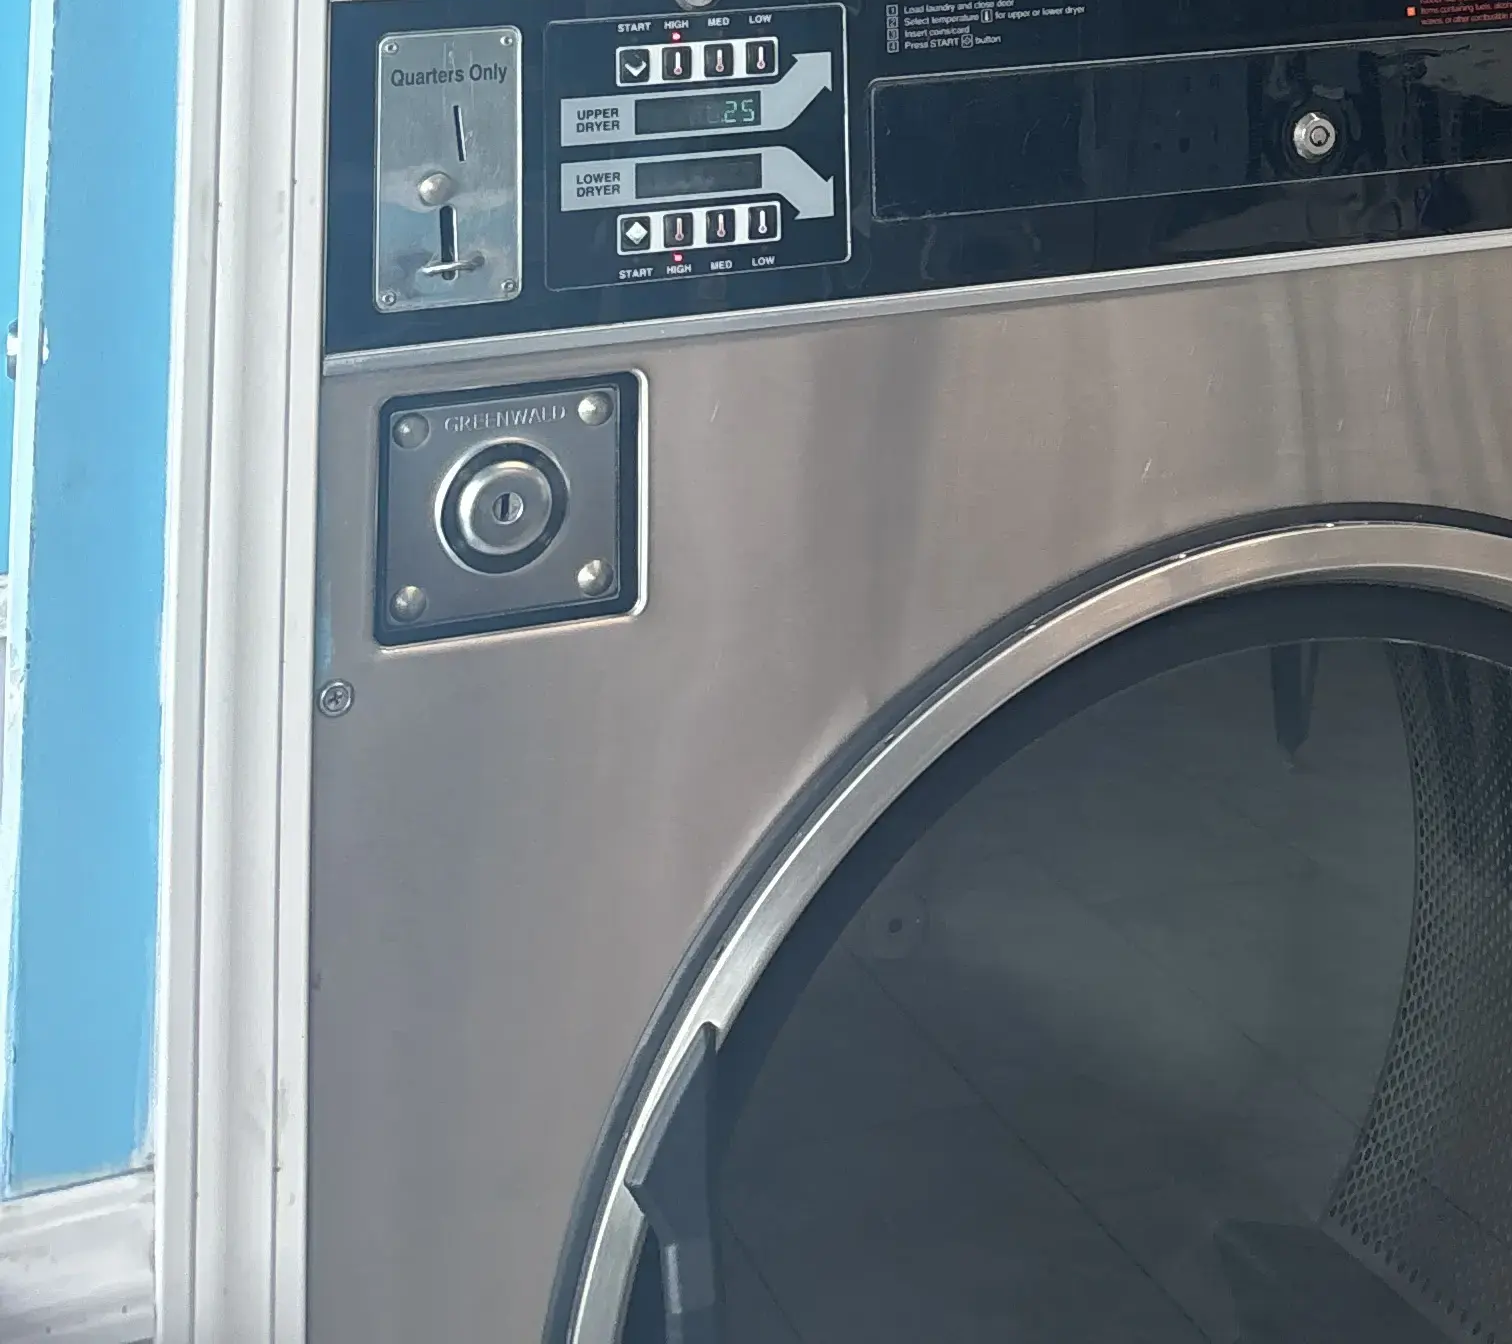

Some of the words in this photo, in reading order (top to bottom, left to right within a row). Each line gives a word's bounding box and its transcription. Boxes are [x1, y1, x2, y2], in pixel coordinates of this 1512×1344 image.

[904, 5, 924, 14] Load
[926, 3, 954, 13] laundry
[957, 1, 972, 10] and
[974, 0, 995, 9] close
[997, 0, 1014, 7] door
[904, 16, 929, 26] Select
[931, 14, 979, 26] temperature
[995, 11, 1005, 19] for
[1007, 10, 1030, 21] upper
[1032, 9, 1040, 17] or
[1042, 7, 1063, 16] lower
[1065, 5, 1085, 16] dryer
[617, 21, 651, 33] START
[664, 18, 690, 30] HIGH
[707, 15, 730, 27] MED
[748, 13, 772, 25] LOW
[905, 29, 927, 38] Insert
[904, 40, 928, 49] Press
[930, 38, 959, 48] START
[975, 36, 1001, 45] button
[390, 67, 466, 88] Quarters
[469, 63, 508, 85] Only
[576, 107, 619, 121] UPPER
[575, 119, 620, 133] DRYER
[575, 171, 621, 186] LOWER
[575, 183, 621, 197] DRYER
[619, 267, 653, 280] START
[666, 263, 692, 275] HIGH
[710, 259, 733, 271] MED
[751, 255, 776, 267] LOW
[444, 405, 567, 434] GREENWALD
